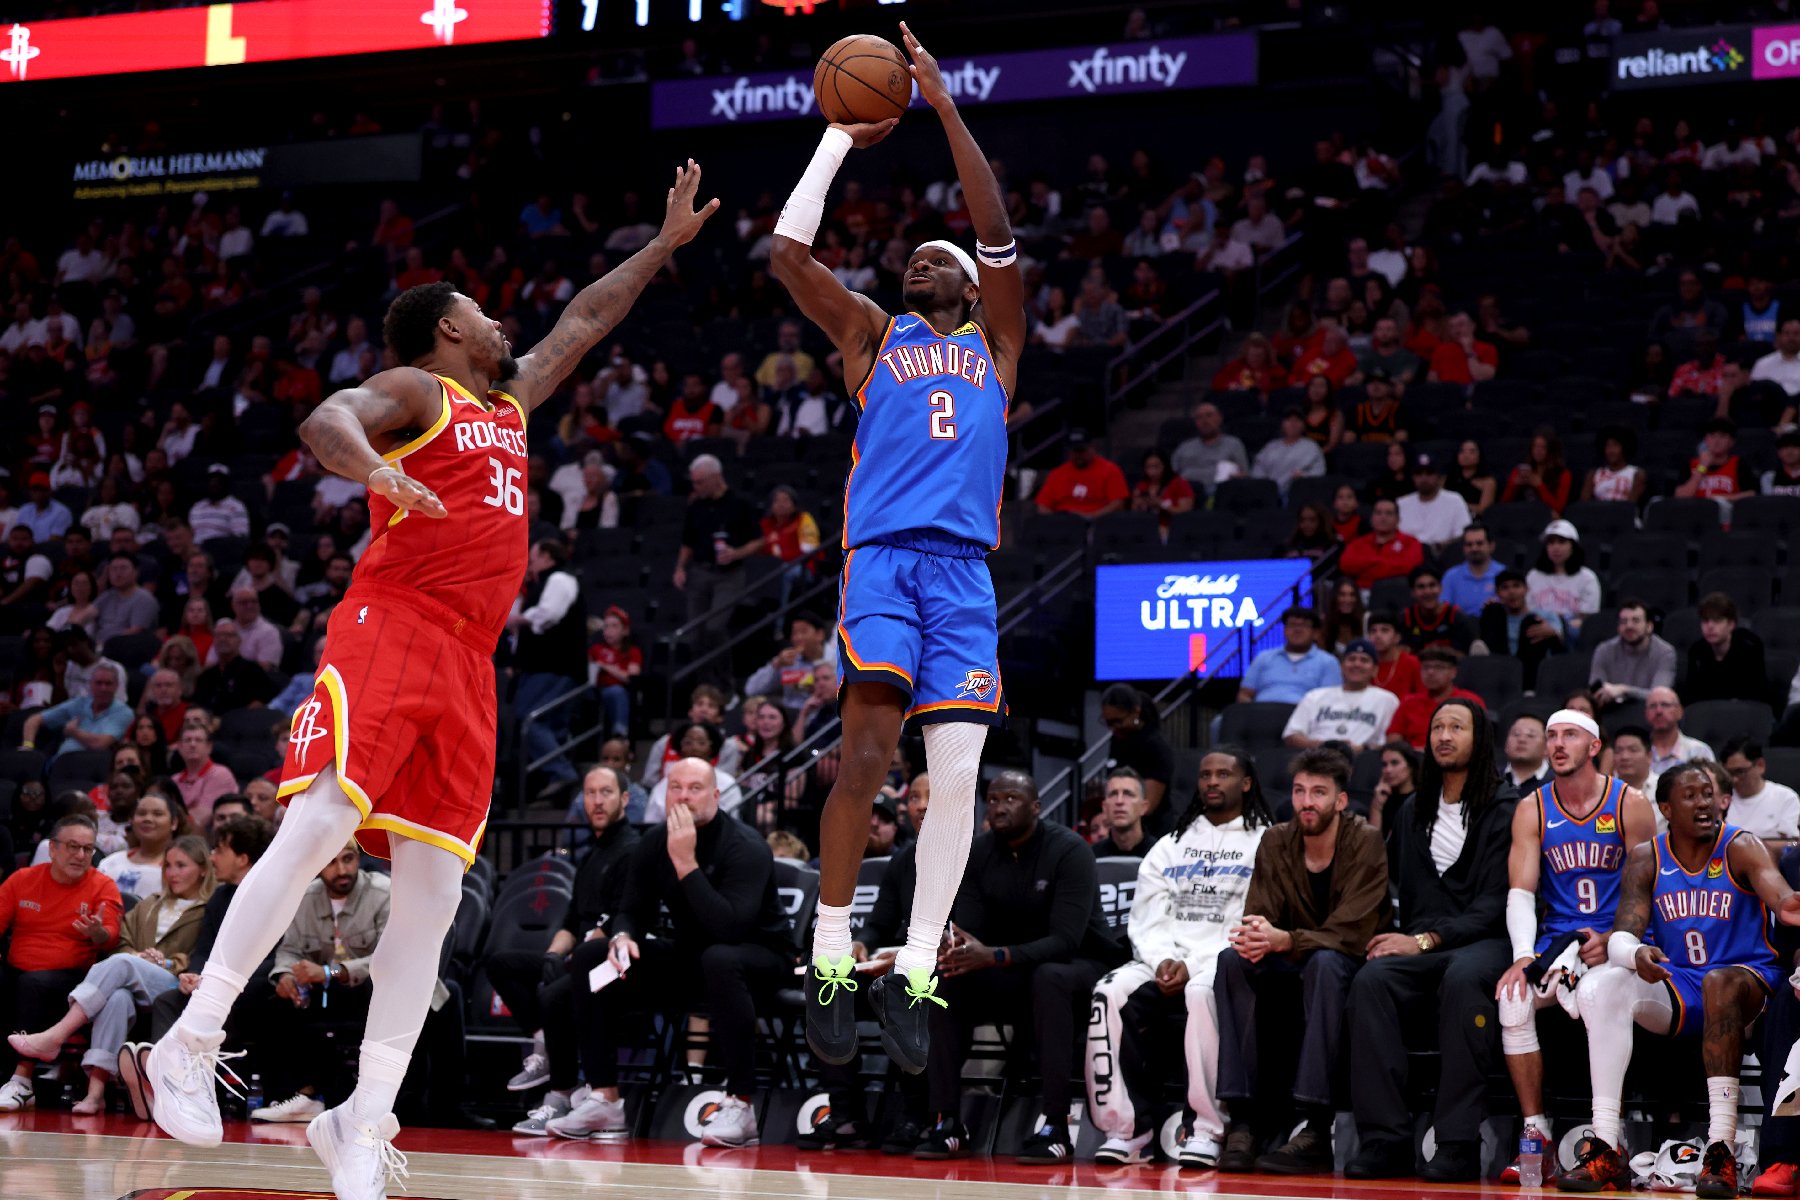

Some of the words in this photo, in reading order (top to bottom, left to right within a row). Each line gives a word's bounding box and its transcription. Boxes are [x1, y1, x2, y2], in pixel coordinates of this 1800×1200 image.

[1068, 46, 1187, 93] xfinity
[1618, 45, 1713, 79] reliant
[73, 156, 165, 181] MEMORIAL
[168, 147, 266, 175] HERMANN
[880, 341, 988, 390] THUNDER
[928, 389, 957, 440] 2
[454, 421, 528, 459] ROCKETS
[483, 456, 523, 516] 36
[1141, 596, 1259, 631] ULTRA
[1182, 846, 1244, 862] Paraclete
[1543, 841, 1625, 874] THUNDER
[1575, 876, 1598, 915] 9
[1654, 889, 1733, 923] THUNDER
[1683, 929, 1708, 967] 8
